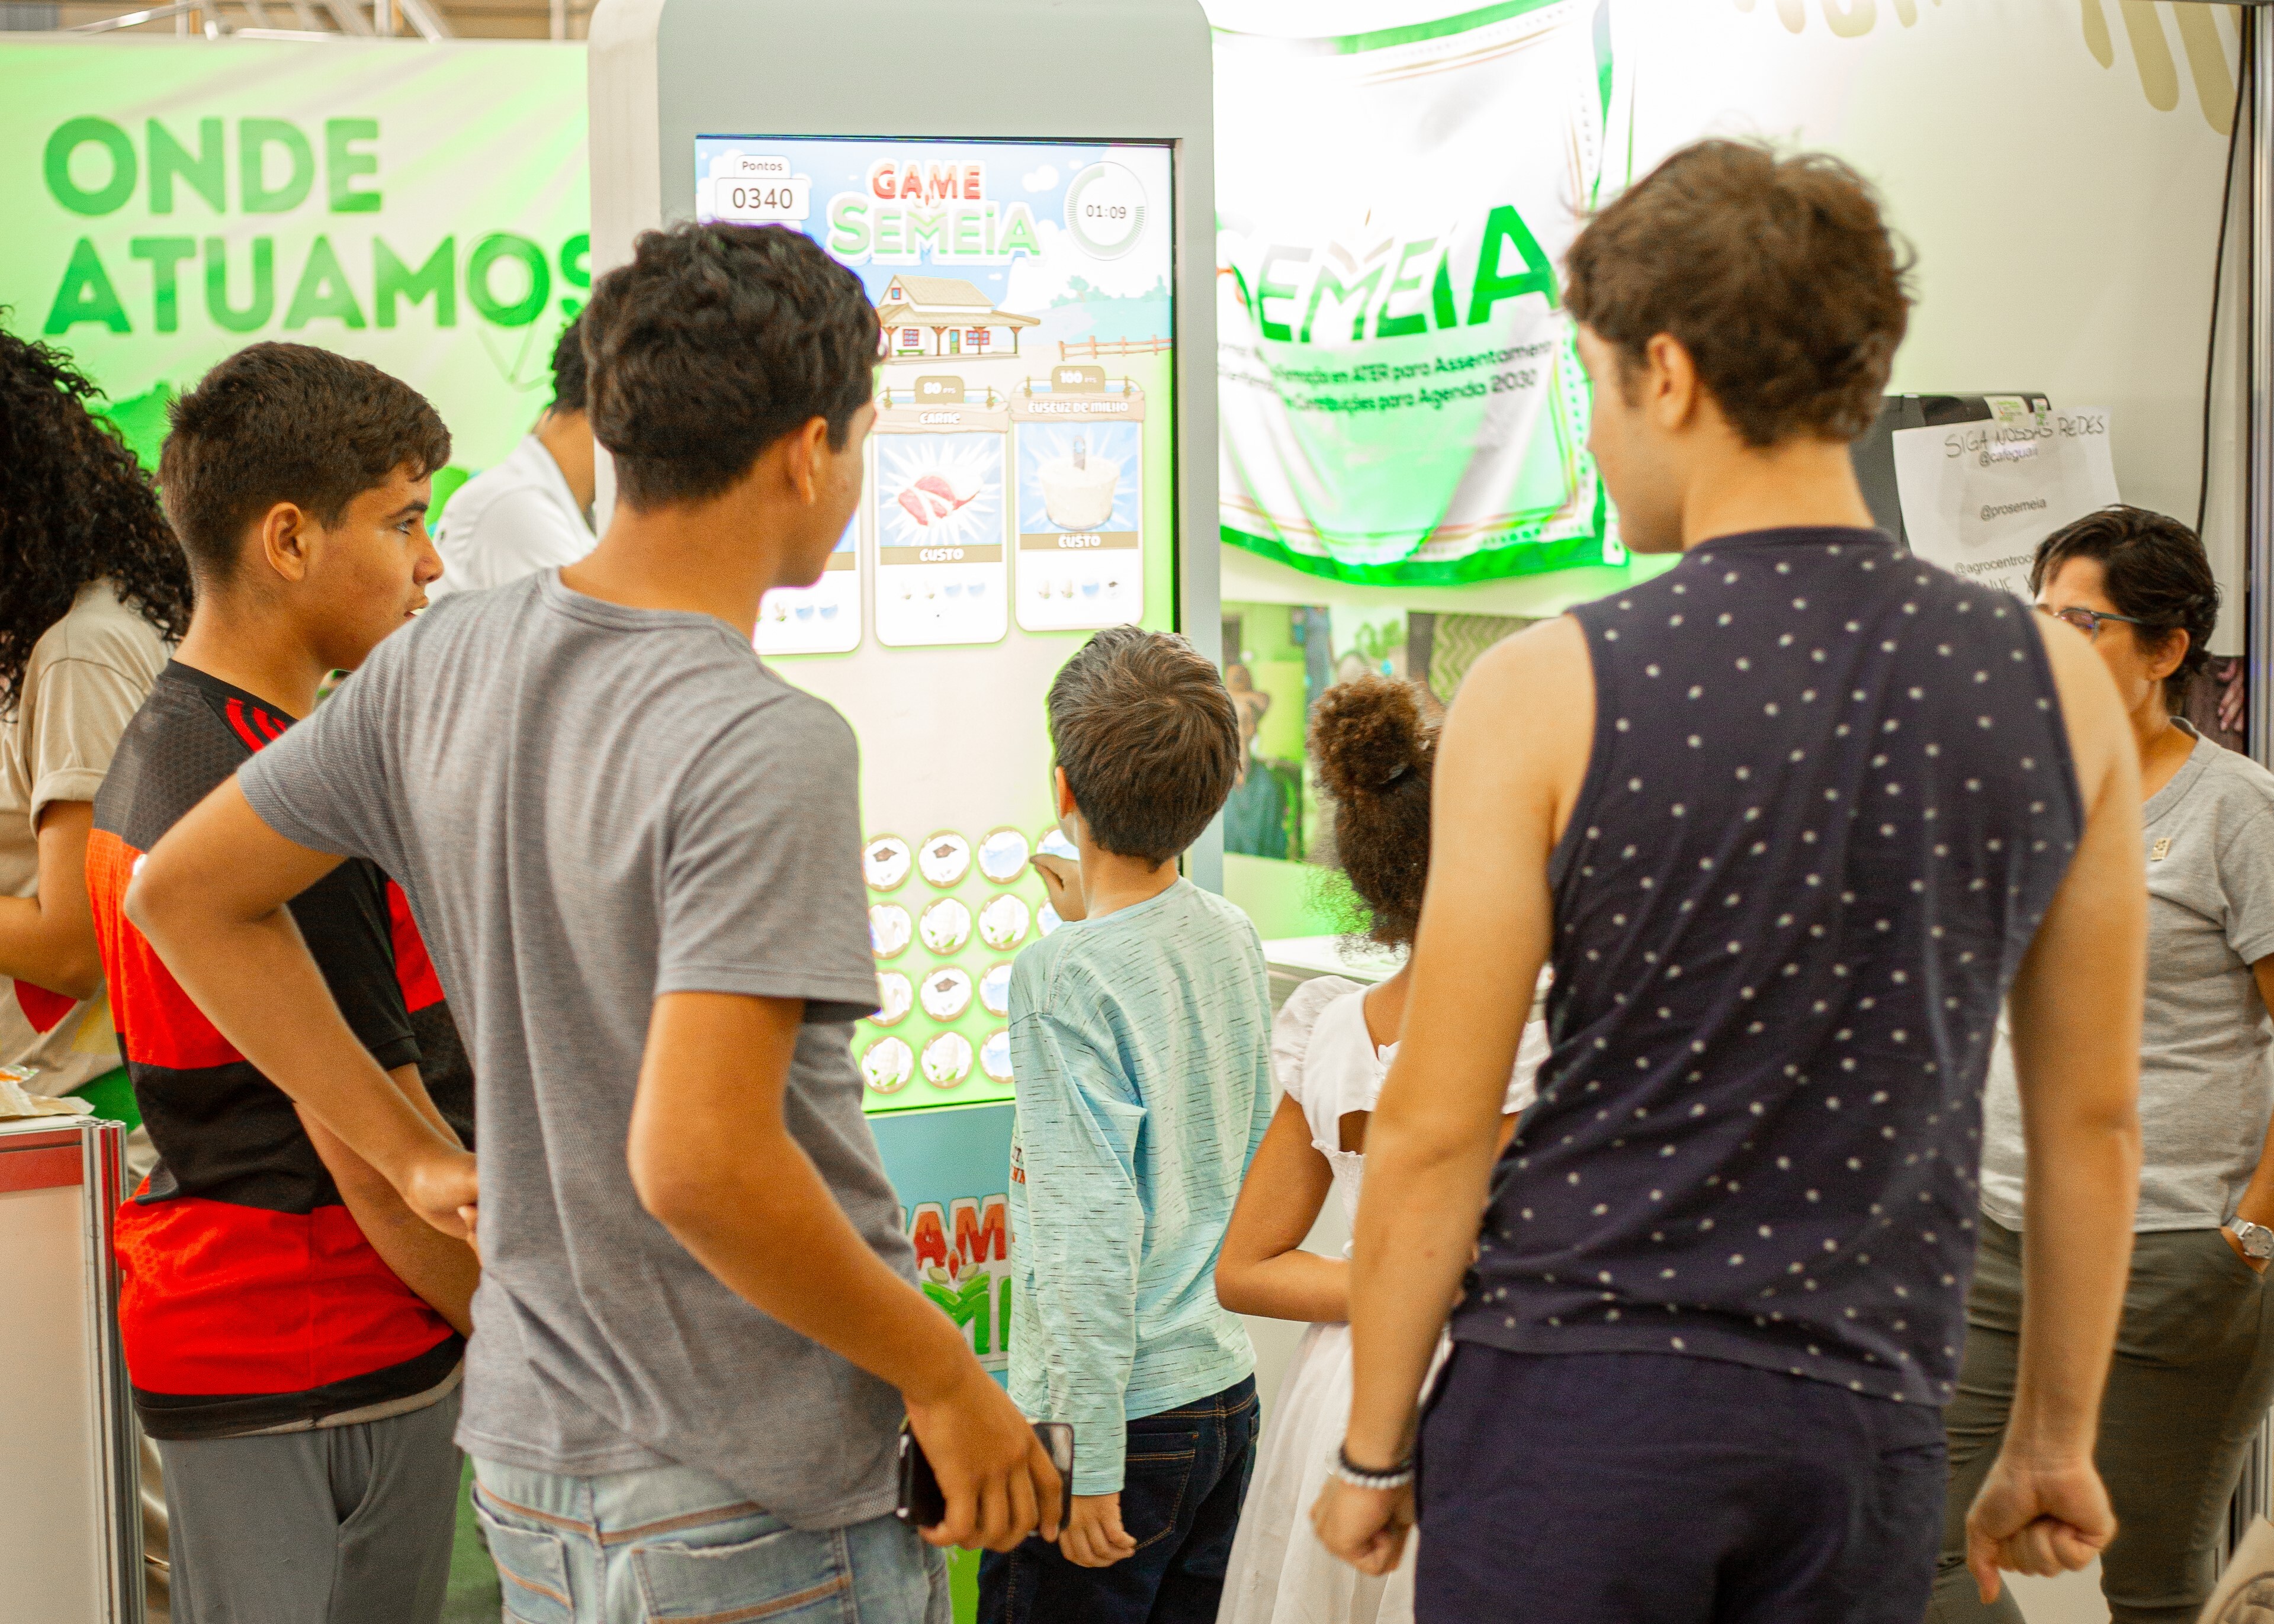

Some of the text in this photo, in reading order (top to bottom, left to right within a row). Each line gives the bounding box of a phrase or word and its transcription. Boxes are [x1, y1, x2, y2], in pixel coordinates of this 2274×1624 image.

[43, 115, 383, 216] ONDE
[741, 160, 783, 171] Pontos
[872, 163, 982, 200] GAME
[732, 187, 794, 209] 0340
[1085, 204, 1127, 220] 01:09
[1059, 370, 1084, 384] 100
[923, 381, 942, 395] 80
[1027, 402, 1071, 414] CUSCUZ
[1090, 401, 1129, 413] MILHO
[1944, 430, 1988, 458] SIGA
[2057, 415, 2104, 438] REDES
[1980, 498, 2047, 522] @prosemeia
[1058, 533, 1101, 548] CUSTO
[919, 548, 965, 562] CUSTO
[1955, 553, 2037, 577] @agrocentroo
